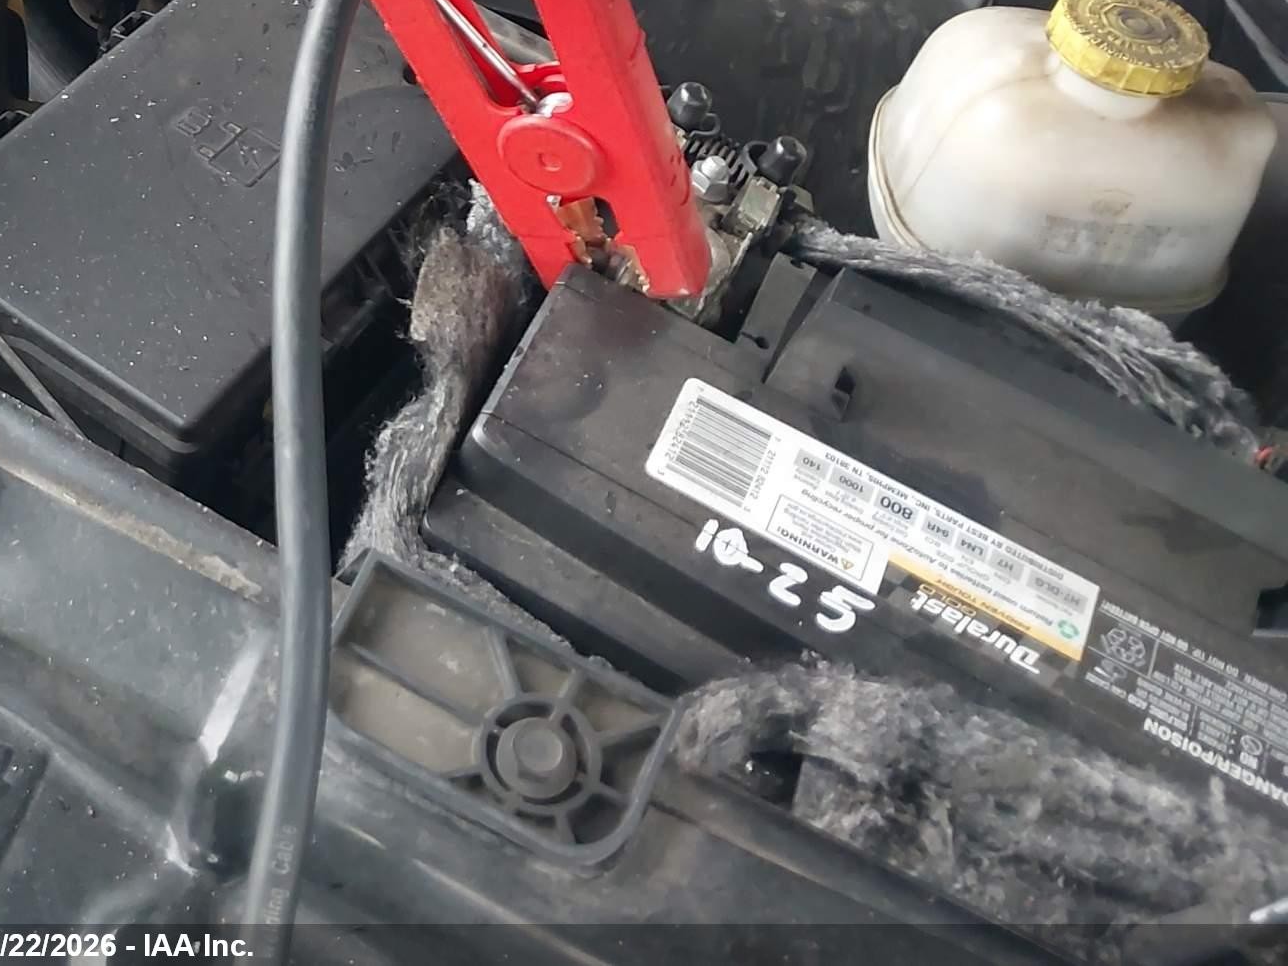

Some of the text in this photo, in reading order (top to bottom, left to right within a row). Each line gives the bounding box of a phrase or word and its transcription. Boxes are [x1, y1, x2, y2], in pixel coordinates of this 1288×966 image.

[802, 455, 821, 472] 140
[824, 451, 850, 469] 38103
[851, 465, 862, 476] TN
[838, 473, 864, 493] 1000
[864, 471, 908, 500] MEMPHIS,
[799, 487, 843, 515] recycling
[879, 494, 912, 521] 800
[910, 494, 930, 511] INC.,
[841, 508, 876, 532] proper
[931, 505, 963, 528] PARTS,
[872, 526, 890, 541] for
[926, 519, 949, 538] 94R
[966, 524, 988, 541] BEST
[776, 524, 839, 564] WARNING:
[888, 535, 937, 565] AutoZone
[960, 537, 983, 556] LN4
[935, 559, 949, 571] to
[997, 557, 1013, 572] H7
[935, 577, 977, 604] TOUGH
[948, 566, 993, 594] batteries
[1034, 575, 1079, 606] H7-DLG
[919, 581, 976, 618] GOLD
[1017, 602, 1054, 627] Return
[906, 589, 1041, 674] Duralast
